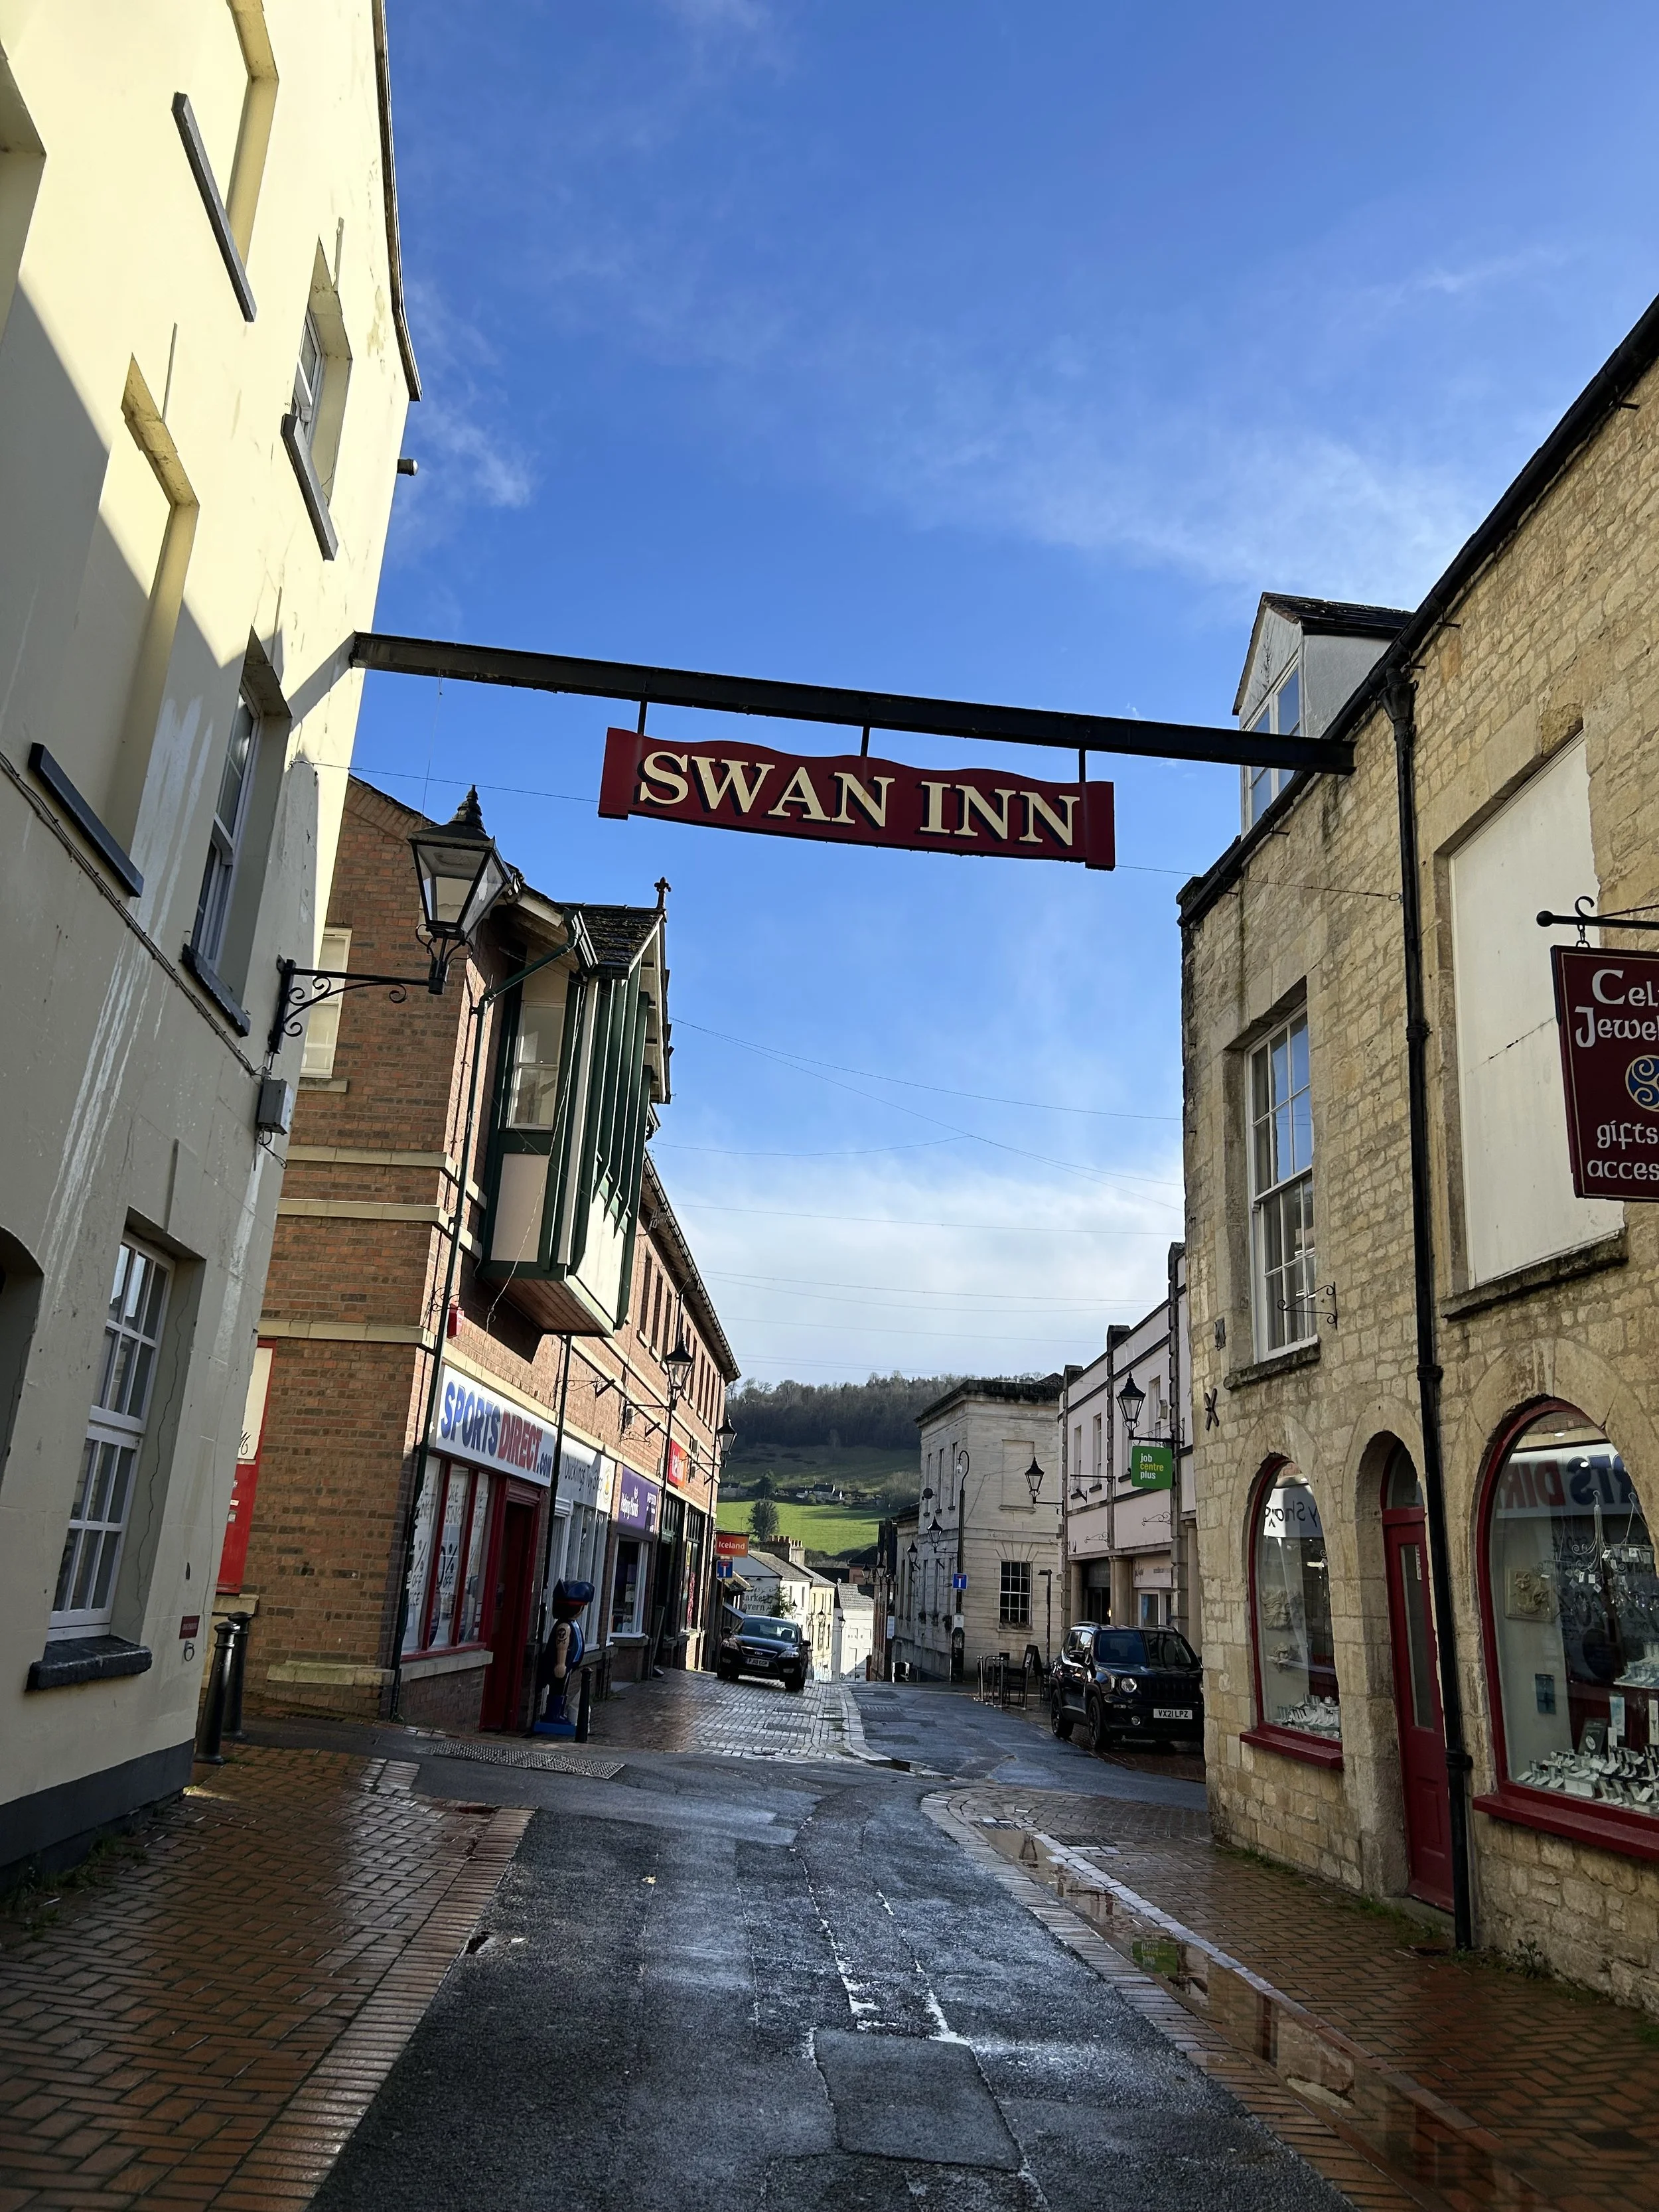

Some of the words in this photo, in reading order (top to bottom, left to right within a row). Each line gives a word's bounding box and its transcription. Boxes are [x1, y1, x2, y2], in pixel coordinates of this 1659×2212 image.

[638, 751, 895, 828] SWAN
[920, 781, 1081, 847] INN
[1591, 968, 1659, 1007] Cel
[1597, 1120, 1659, 1150] gifts
[1140, 1453, 1153, 1463] job
[1140, 1463, 1164, 1471] centre
[1140, 1471, 1156, 1480] plus
[719, 1541, 745, 1550] Iceland
[743, 1593, 768, 1603] arket
